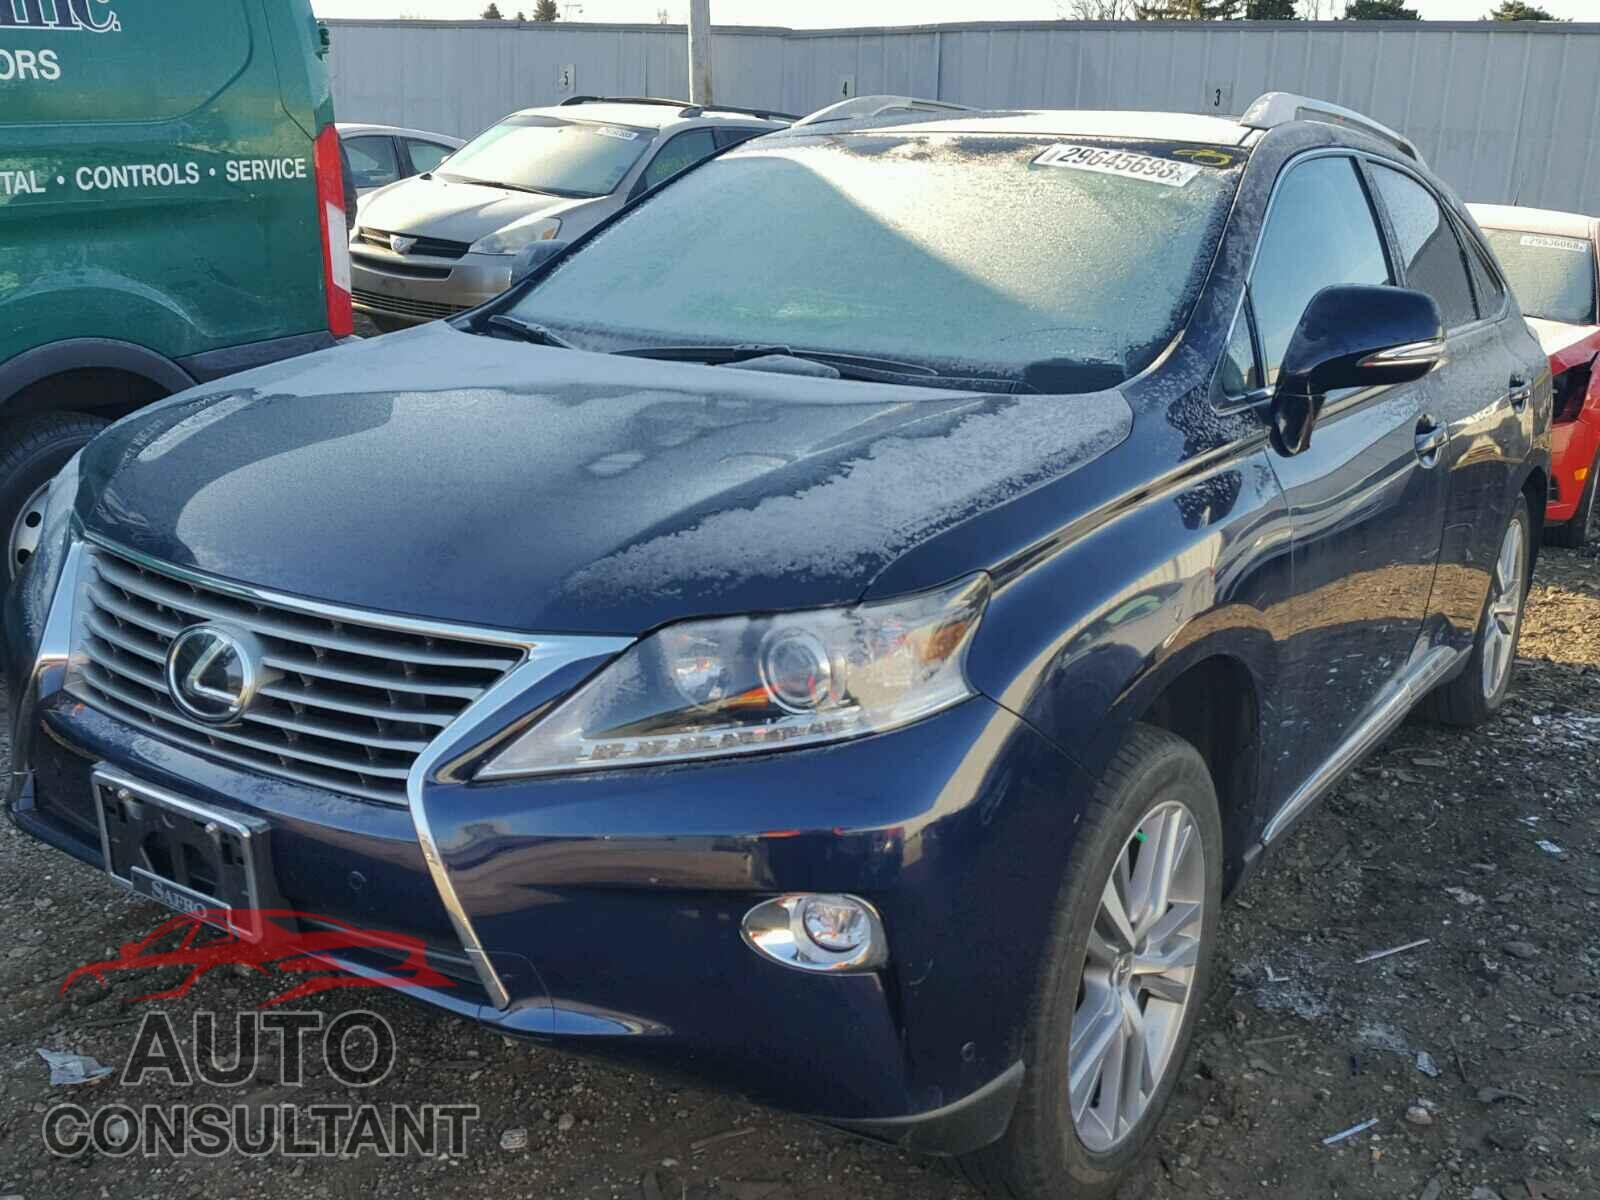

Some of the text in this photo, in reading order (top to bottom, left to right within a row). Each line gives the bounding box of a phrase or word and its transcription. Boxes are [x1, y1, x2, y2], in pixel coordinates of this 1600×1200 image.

[1213, 88, 1222, 107] 3
[0, 158, 307, 195] TAL CONTROLS SERVICE
